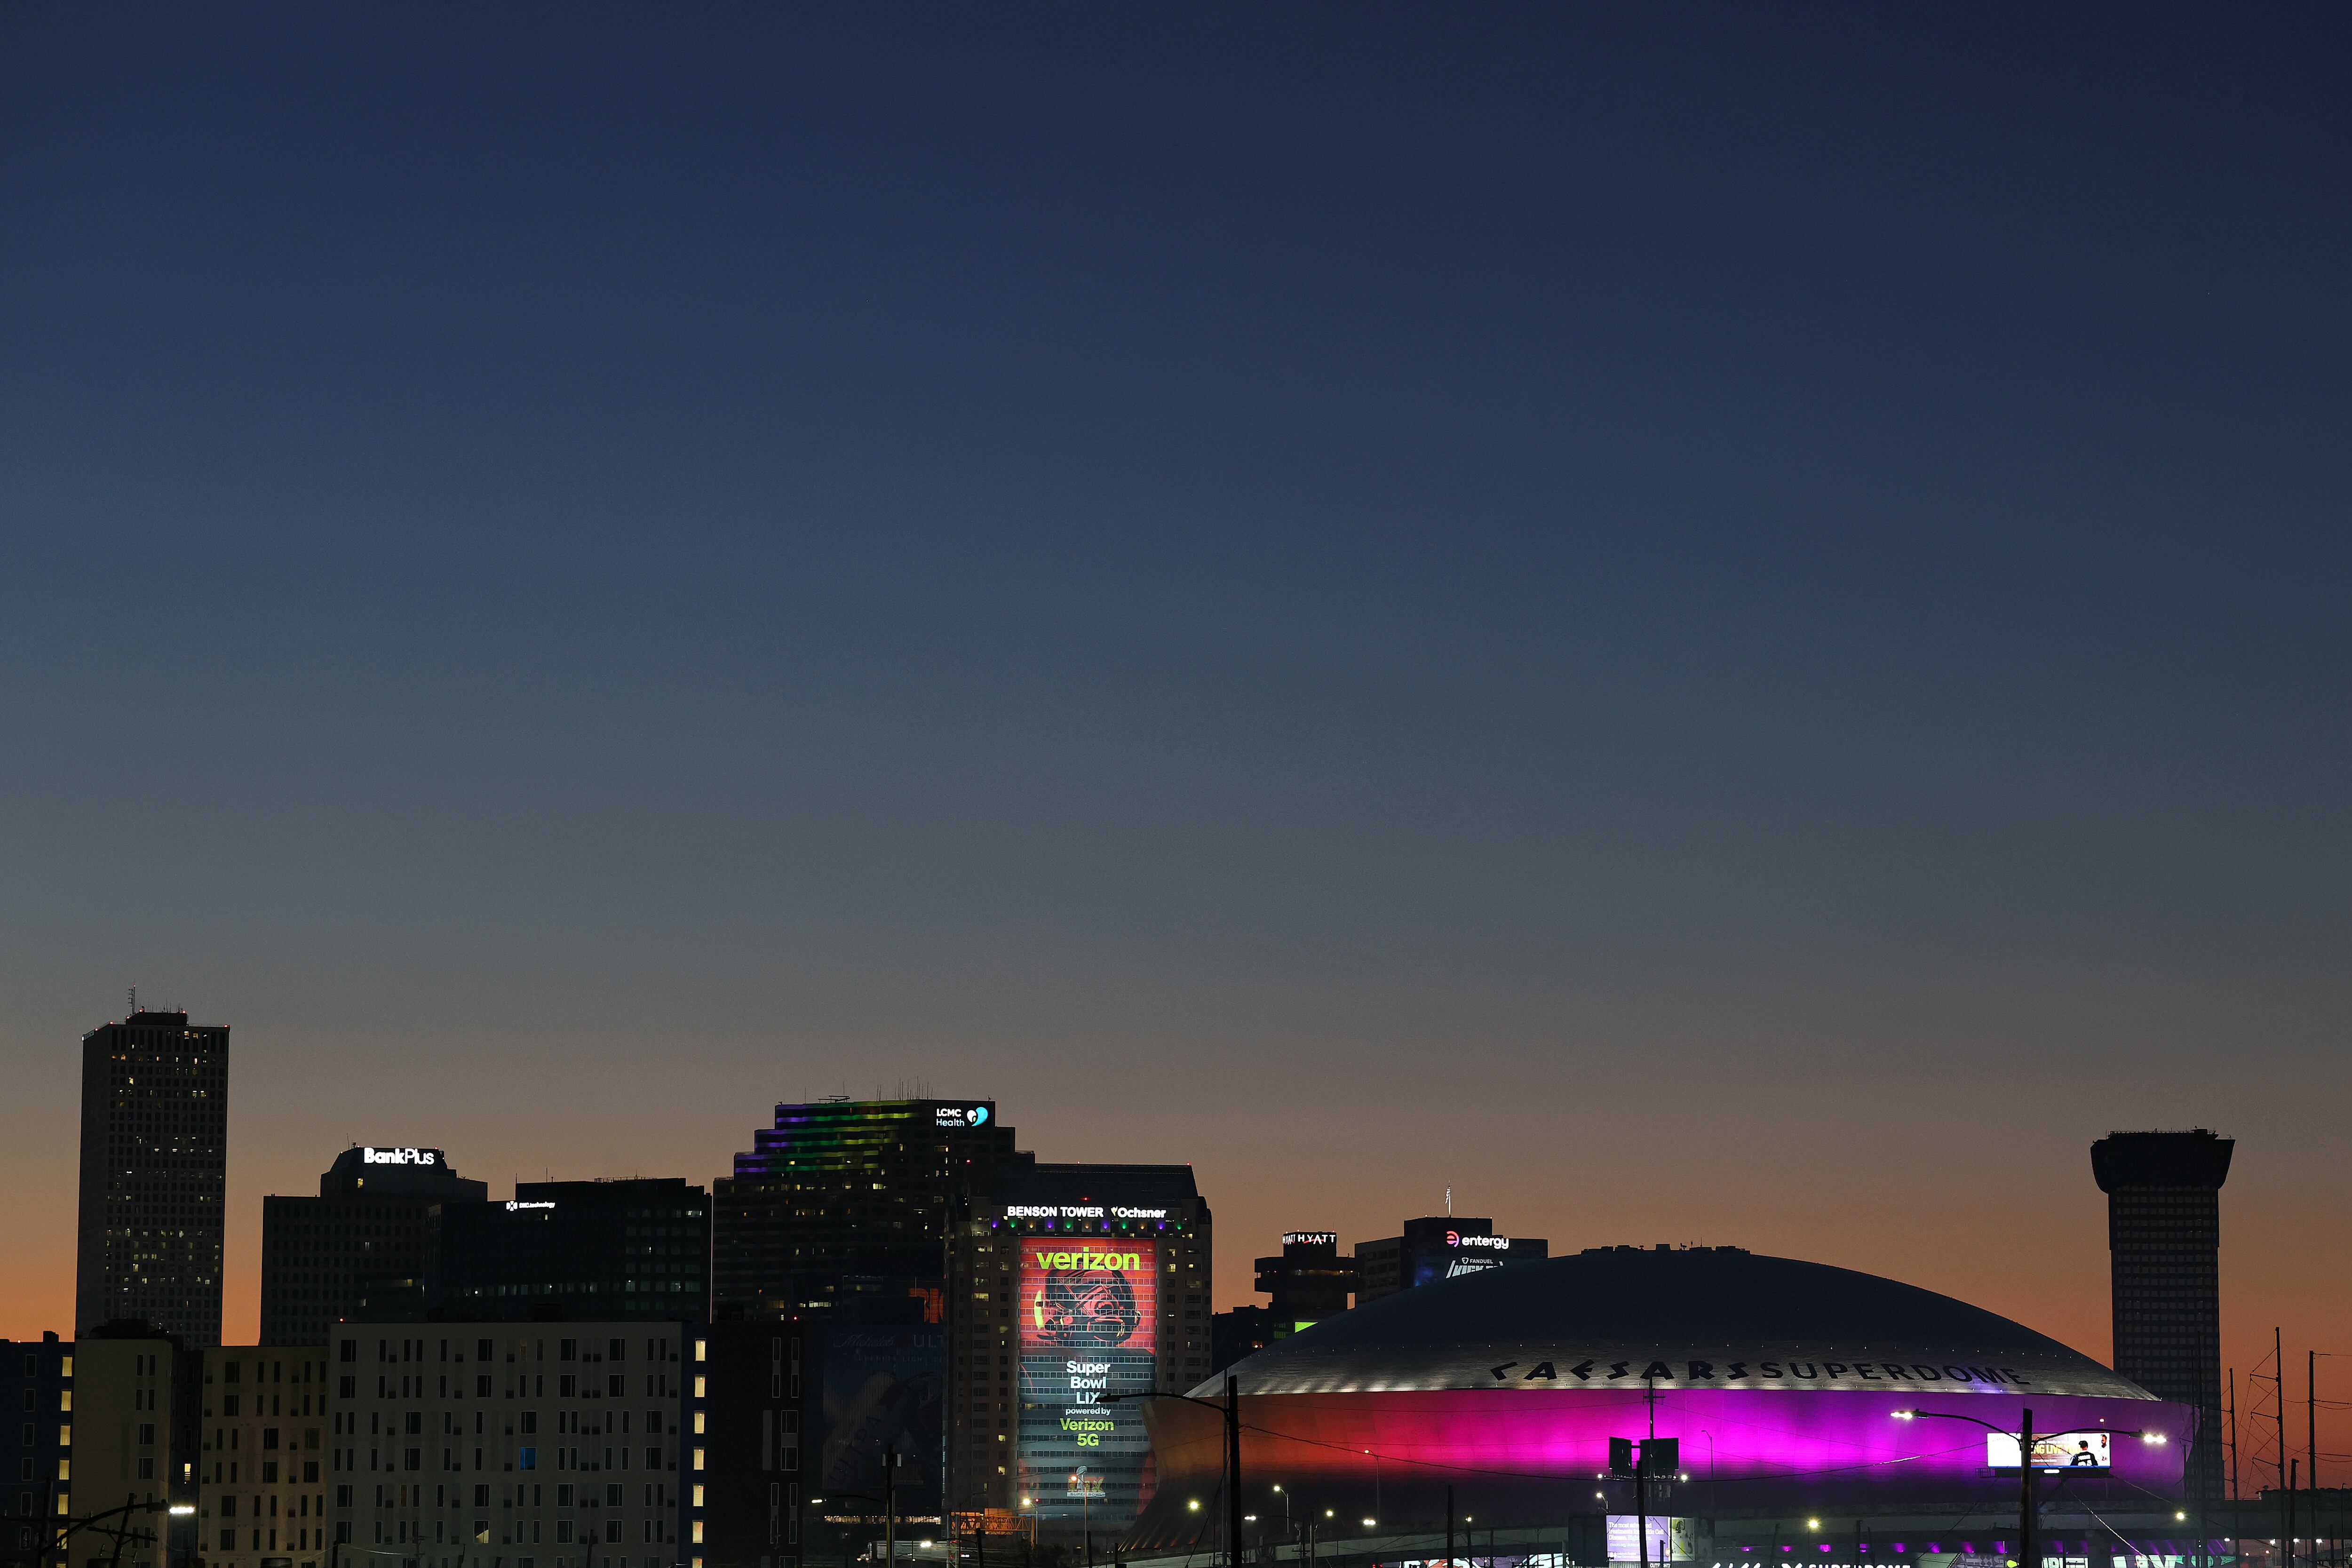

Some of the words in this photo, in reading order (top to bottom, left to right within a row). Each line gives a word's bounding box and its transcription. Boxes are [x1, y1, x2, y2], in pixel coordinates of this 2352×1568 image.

[937, 1108, 961, 1117] LCMC
[364, 1147, 435, 1165] BankPlus
[1008, 1206, 1057, 1217] BENSON
[1060, 1206, 1104, 1218] TOWER
[1117, 1207, 1167, 1218] Ochsner
[1282, 1234, 1296, 1245] HYATT
[1298, 1234, 1336, 1245] HYATT
[1462, 1235, 1509, 1250] entergy
[1036, 1247, 1140, 1270] verizon
[1066, 1360, 1111, 1376] Super
[1490, 1359, 1749, 1381] CAESARS
[1760, 1362, 2031, 1385] SUPERDOME
[1070, 1376, 1106, 1388] Bowl
[1076, 1392, 1101, 1404] LIX
[1065, 1407, 1100, 1416] powered
[1101, 1407, 1111, 1416] by
[1059, 1418, 1114, 1431] Verizon
[1077, 1433, 1099, 1446] 5G
[2046, 1444, 2063, 1454] LIVE
